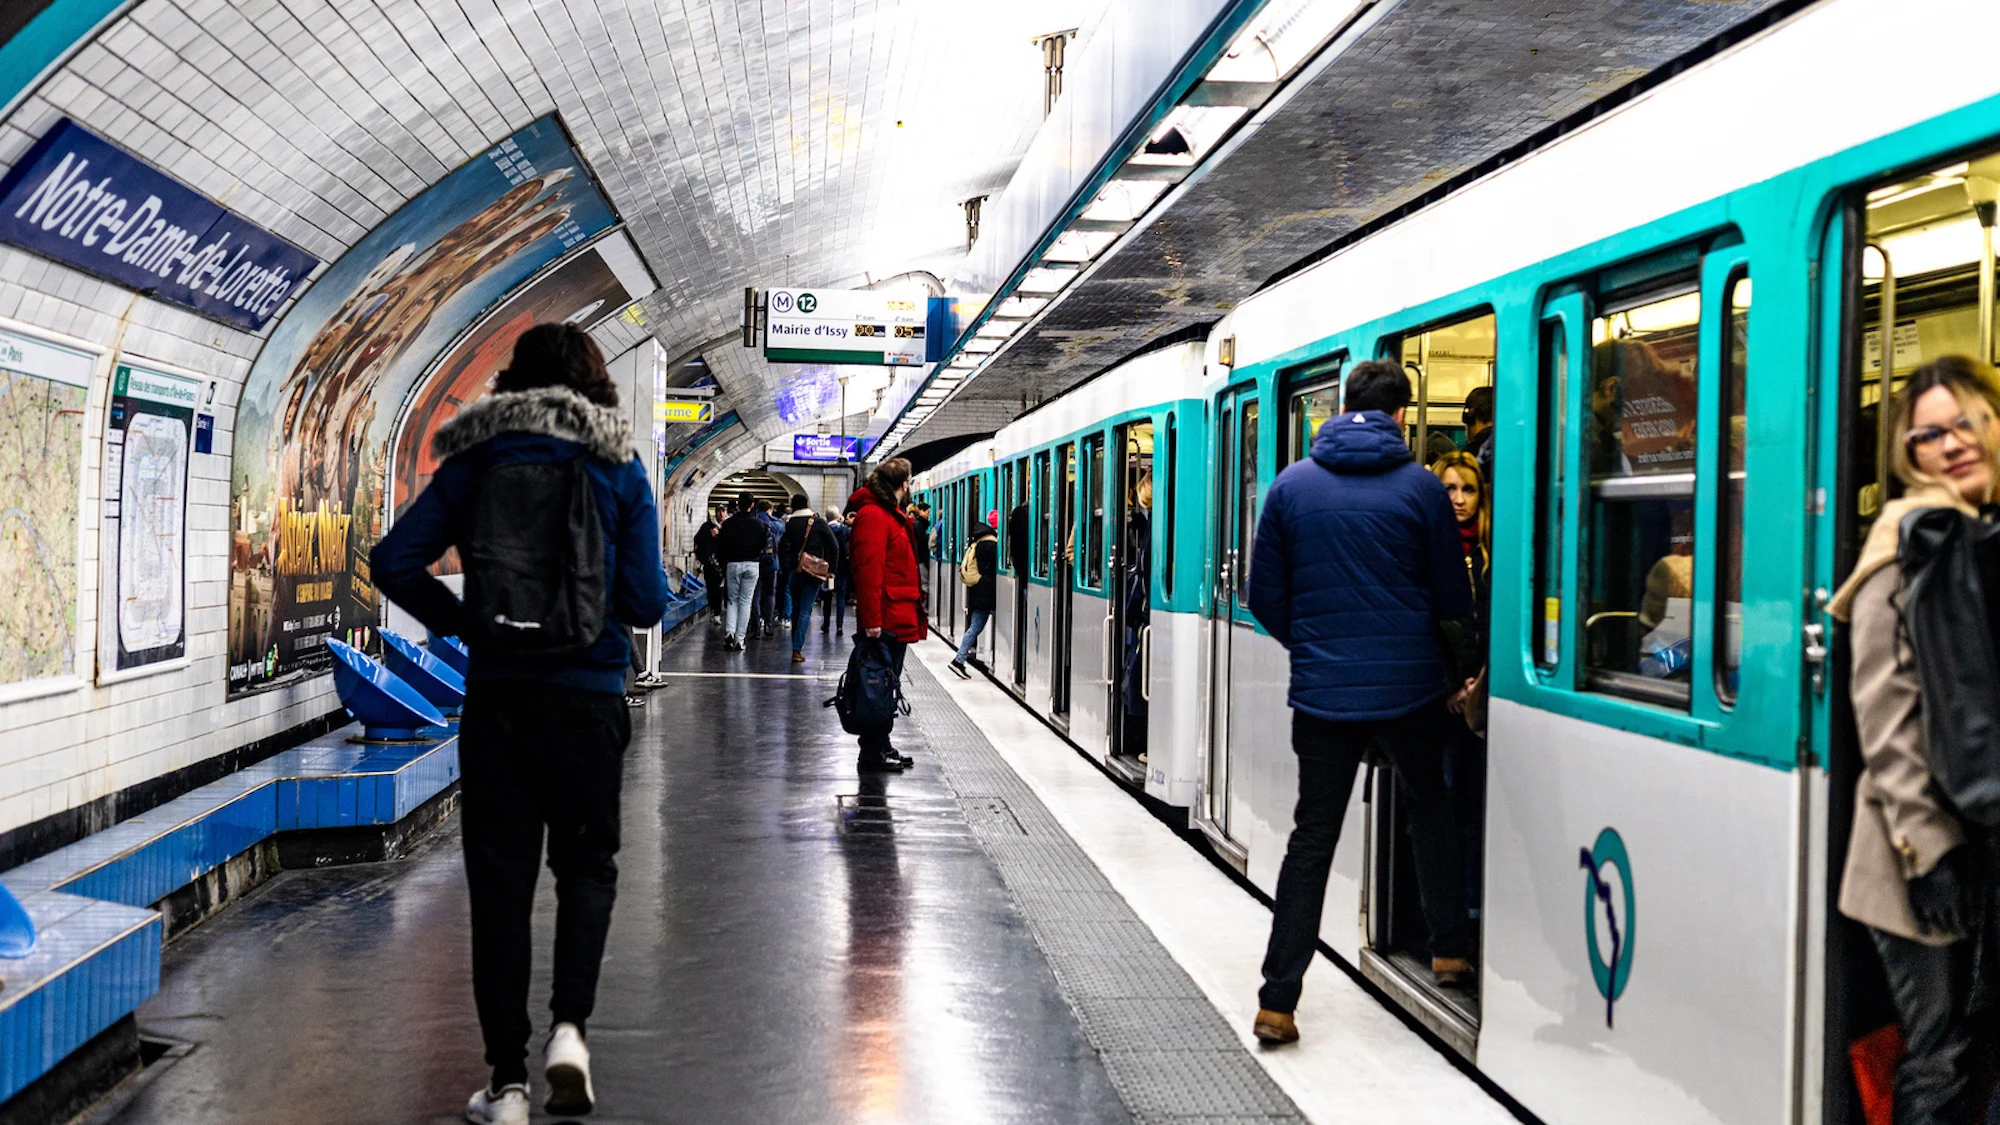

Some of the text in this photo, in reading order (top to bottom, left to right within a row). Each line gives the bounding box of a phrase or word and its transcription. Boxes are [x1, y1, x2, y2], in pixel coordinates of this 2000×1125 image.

[14, 151, 292, 317] Notre-Dame-de-Lorette
[777, 296, 815, 310] M 12
[772, 323, 848, 339] Mairie d'Issy
[854, 325, 915, 338] 00 05
[805, 436, 831, 447] Sortie
